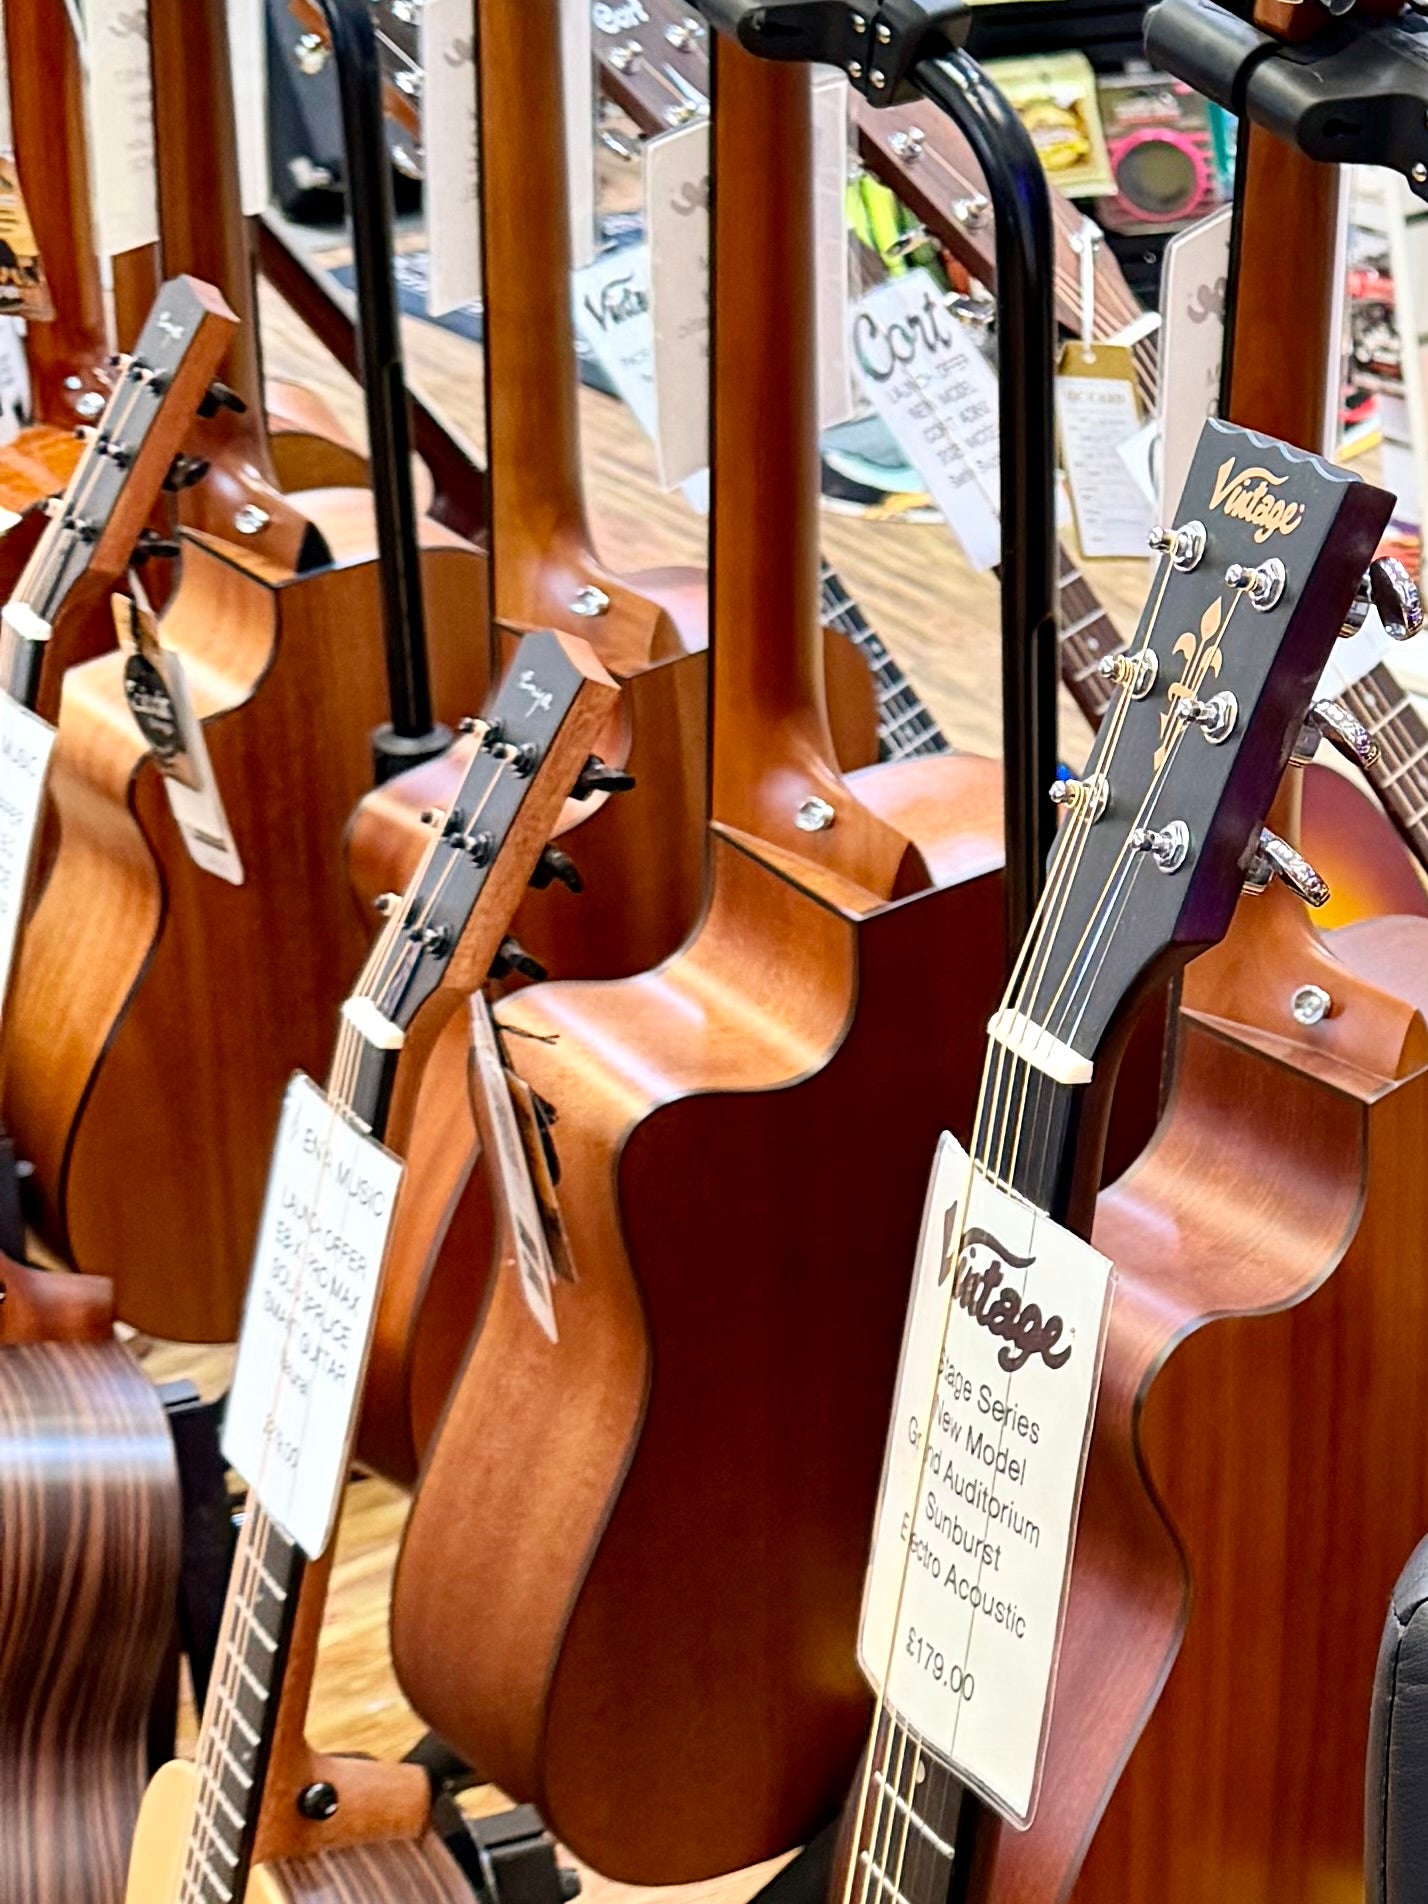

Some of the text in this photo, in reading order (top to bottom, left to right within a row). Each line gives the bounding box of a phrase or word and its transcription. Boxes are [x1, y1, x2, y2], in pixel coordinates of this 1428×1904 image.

[853, 292, 951, 383] Cort
[1209, 456, 1305, 543] Vintage
[337, 1160, 387, 1217] MUSIC
[939, 1199, 1075, 1372] Vintage
[978, 1386, 1041, 1446] Series
[907, 1415, 1041, 1549] Grnd Auditorium
[965, 1427, 1027, 1487] Model
[925, 1491, 1003, 1572] Sunburst
[945, 1568, 1027, 1641] Acoustic
[905, 1624, 977, 1702] £179.00
